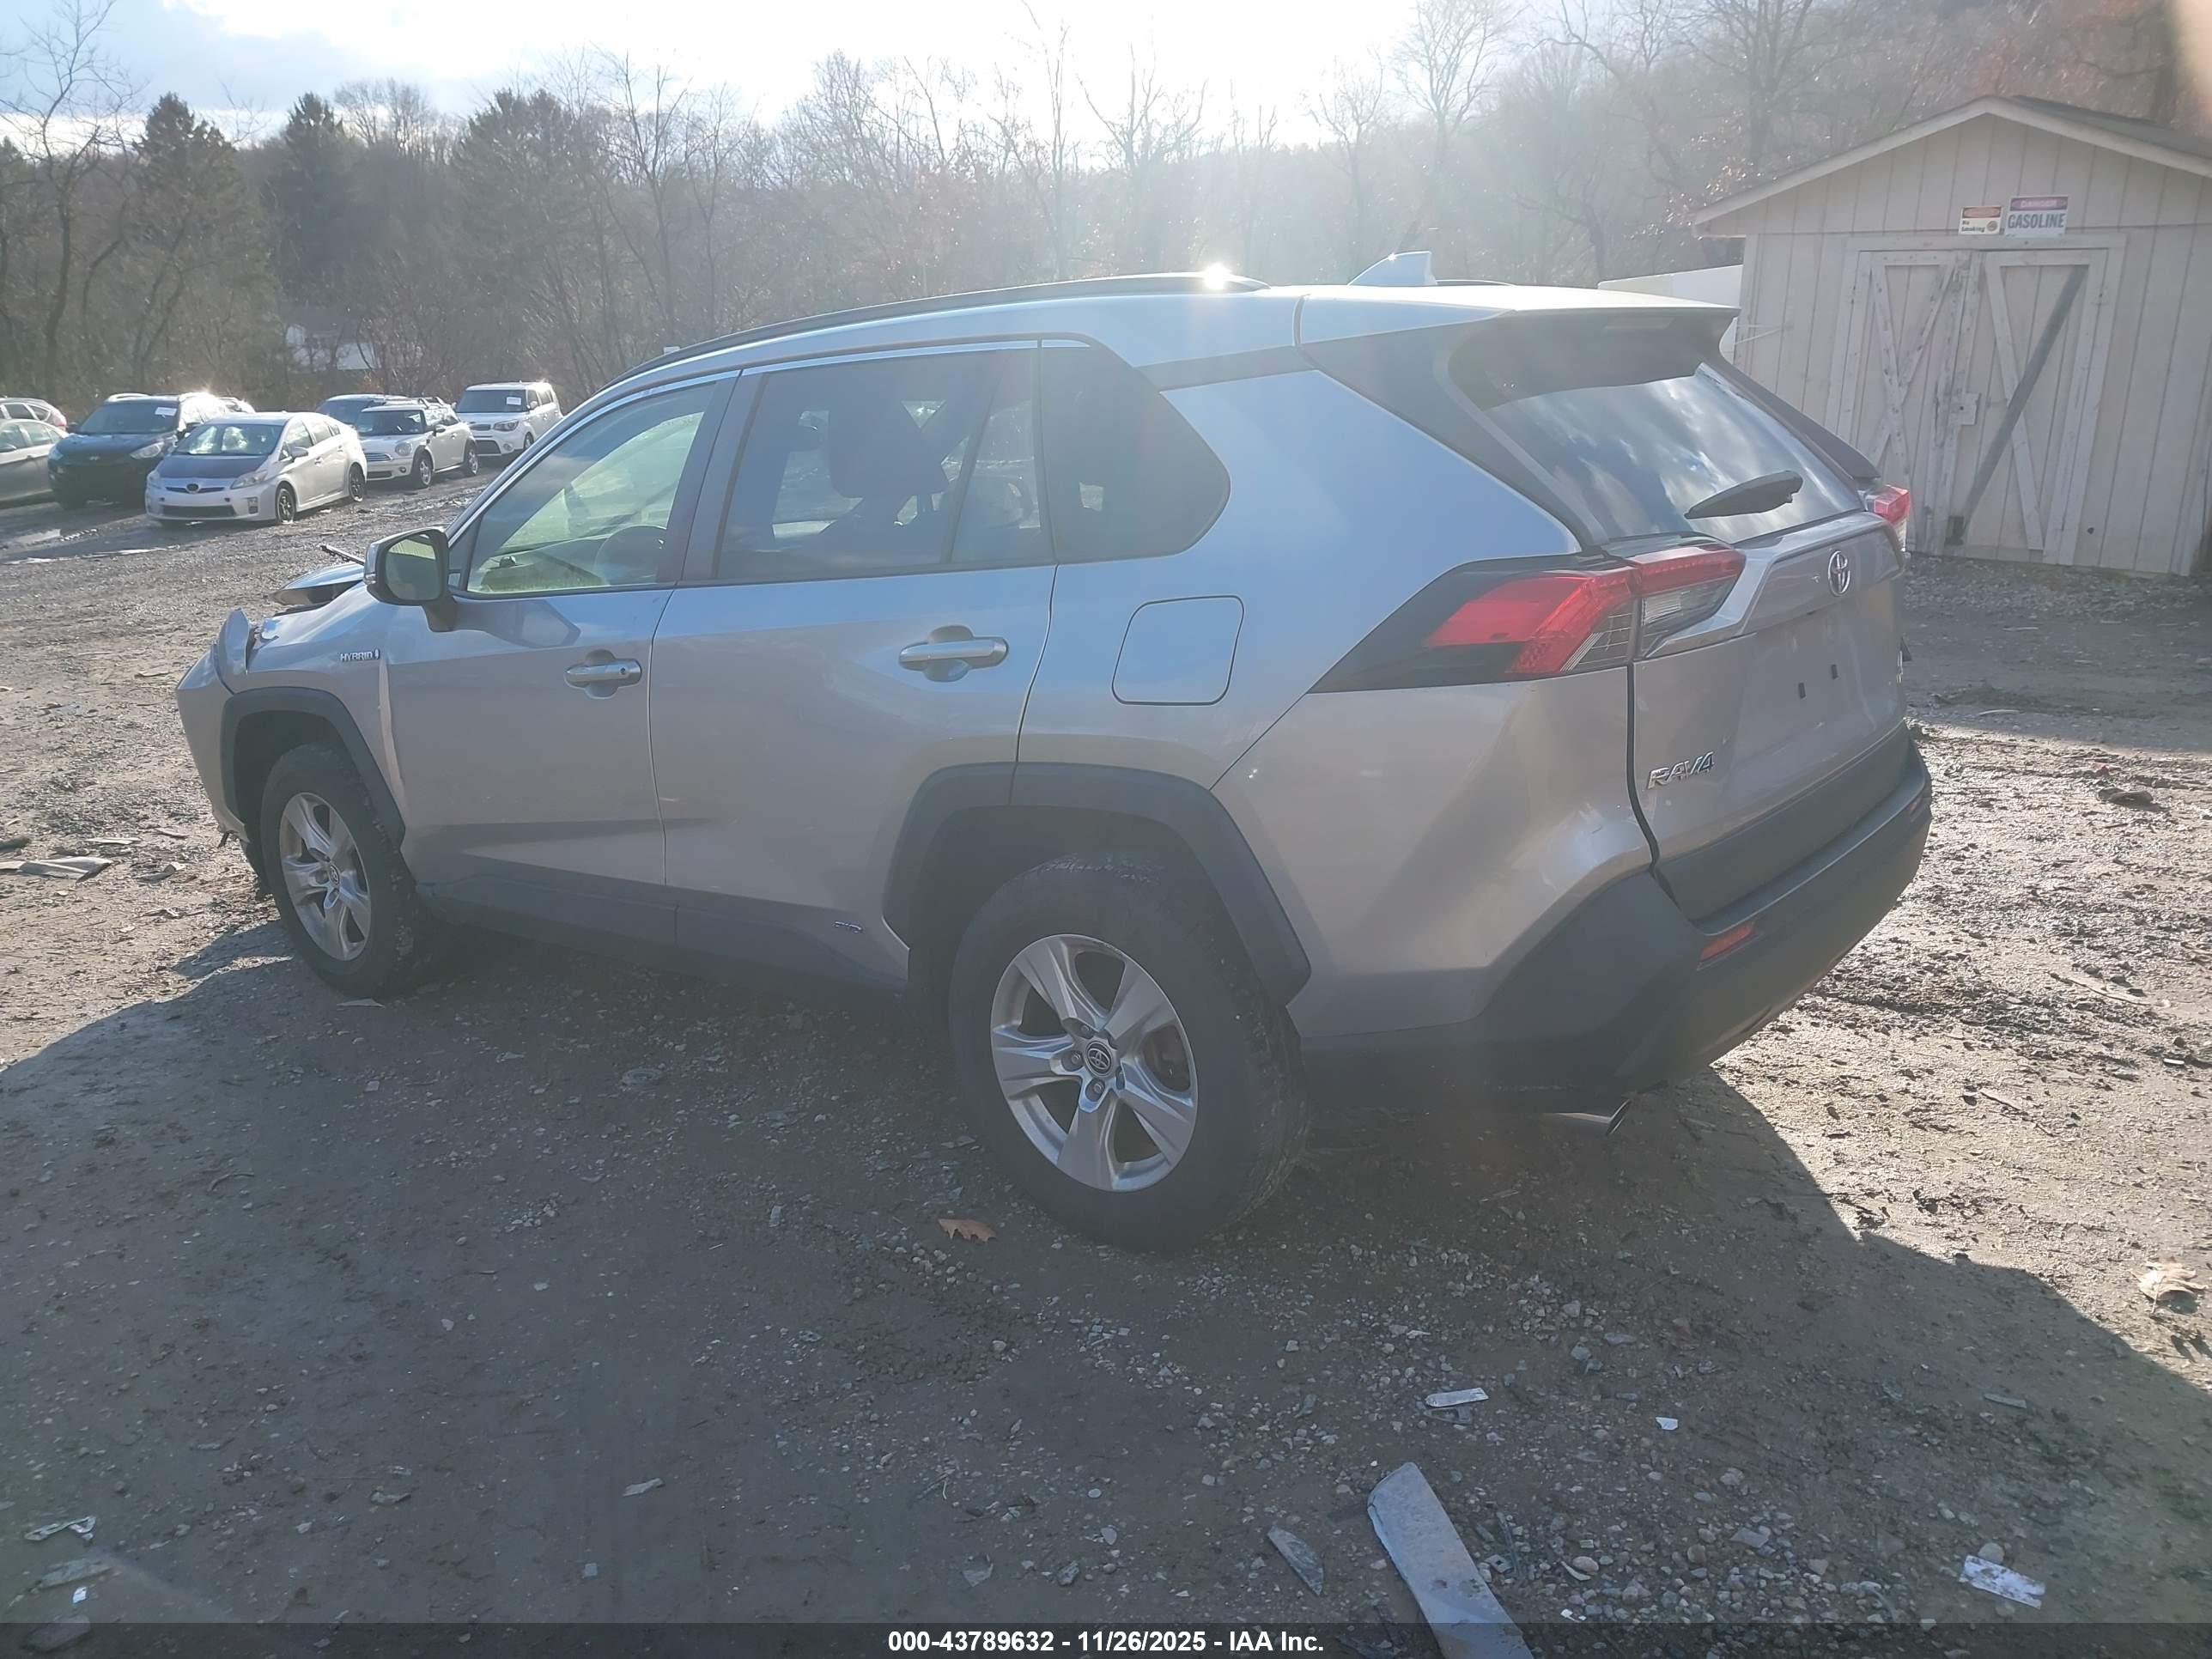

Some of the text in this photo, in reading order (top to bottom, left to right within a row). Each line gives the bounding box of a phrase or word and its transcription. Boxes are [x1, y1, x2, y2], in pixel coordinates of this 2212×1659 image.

[2008, 213, 2066, 229] GASOLINE
[340, 651, 374, 661] HYBRID
[1648, 751, 1716, 790] RAV4
